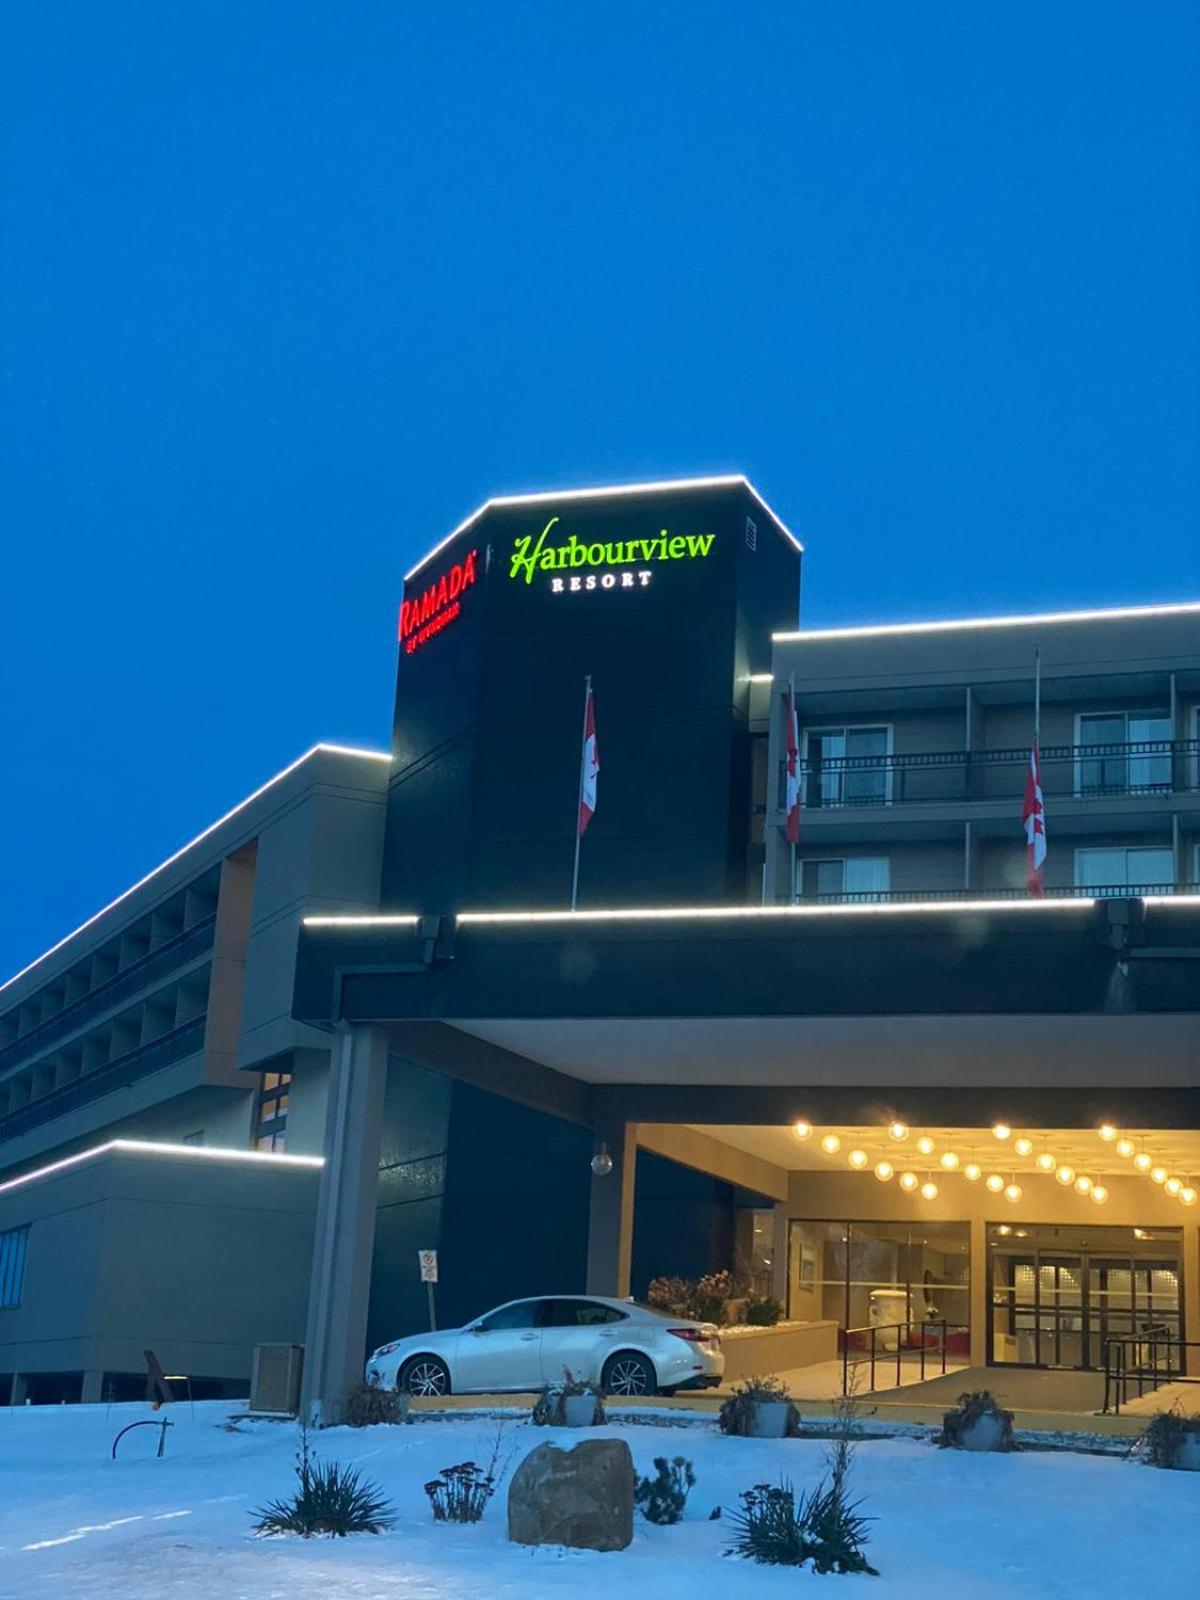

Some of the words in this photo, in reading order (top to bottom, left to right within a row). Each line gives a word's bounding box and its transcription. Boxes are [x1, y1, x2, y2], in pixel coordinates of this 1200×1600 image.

[509, 517, 716, 585] Harbourview
[551, 571, 652, 593] RESORT
[398, 551, 476, 642] RAMADA
